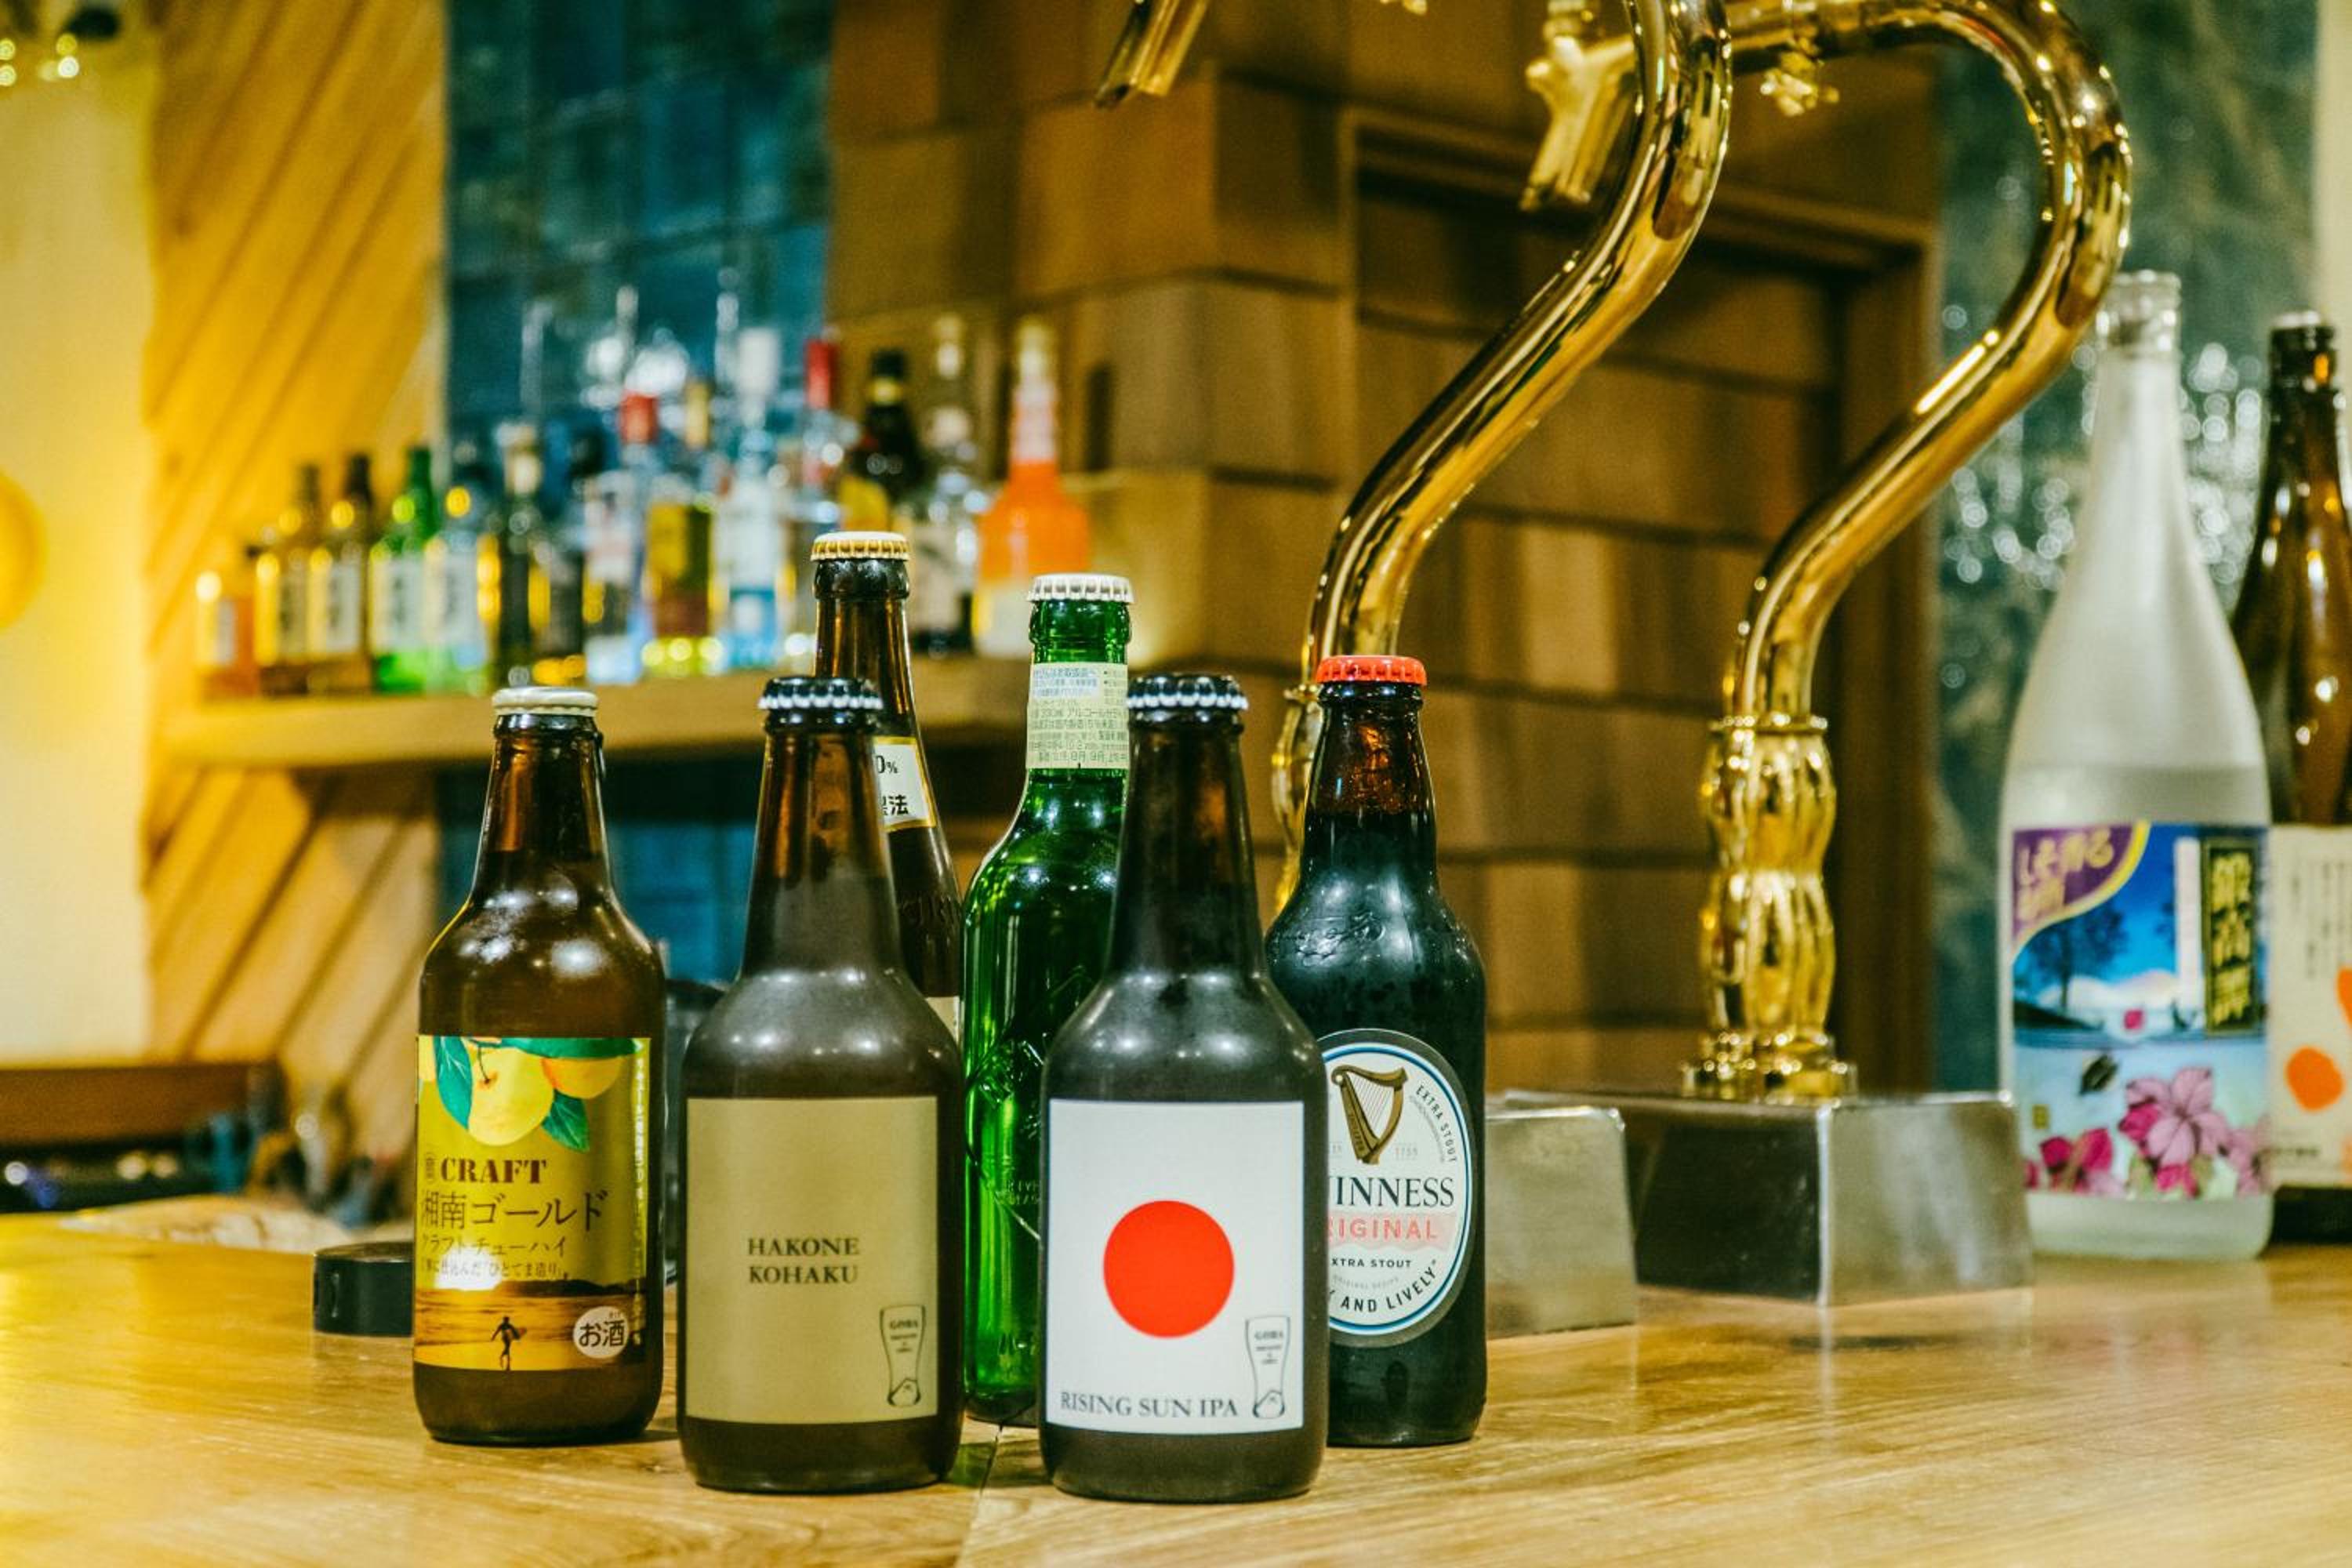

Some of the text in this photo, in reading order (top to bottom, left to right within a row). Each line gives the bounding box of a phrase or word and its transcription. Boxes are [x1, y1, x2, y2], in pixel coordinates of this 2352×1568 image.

[882, 794, 909, 816] 法
[1416, 1084, 1443, 1120] EXTRA
[1440, 1122, 1457, 1162] STOUT
[441, 1157, 546, 1184] CRAFT
[1330, 1176, 1454, 1208] INNESS
[423, 1190, 608, 1232] 湘南ゴールド
[748, 1237, 860, 1256] HAKONE
[750, 1265, 858, 1284] KOHAKU
[1371, 1259, 1412, 1268] STOUT
[1341, 1296, 1377, 1313] AND
[579, 1320, 625, 1348] お酒
[1061, 1391, 1238, 1417] RISING SUN IPA
